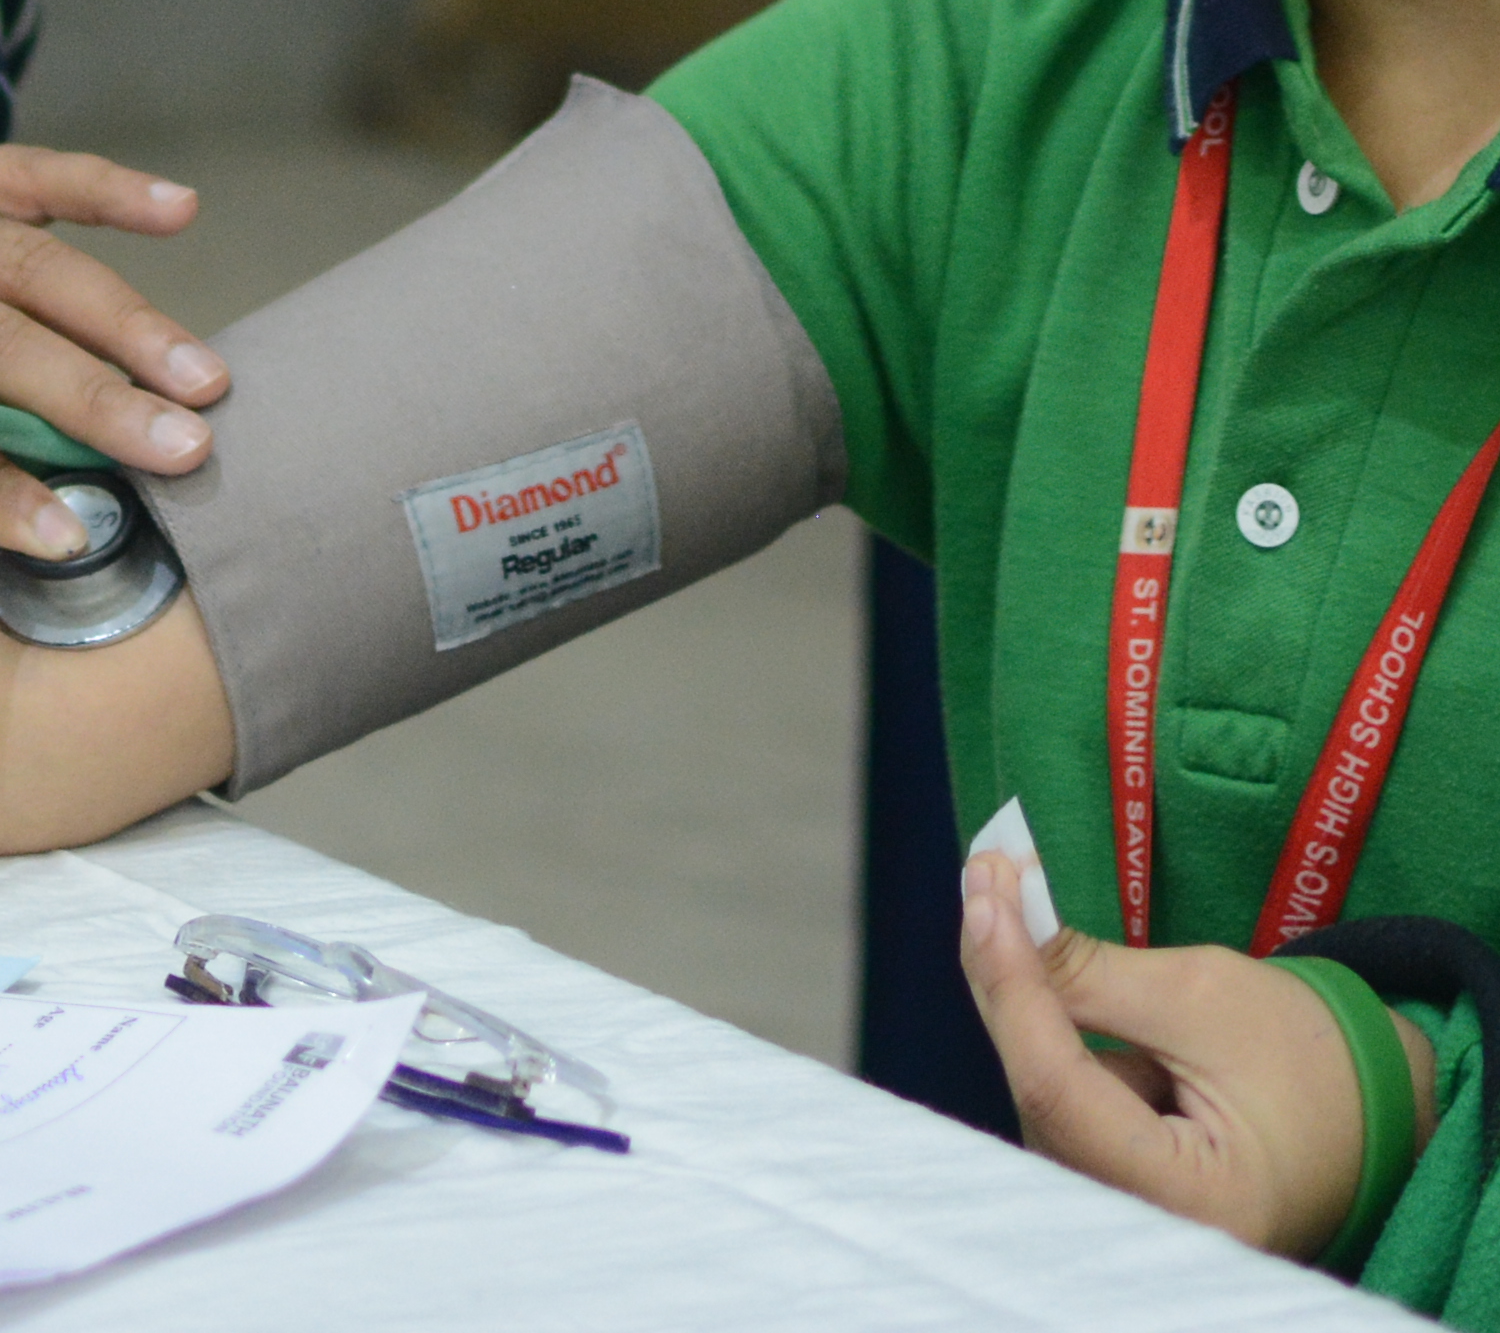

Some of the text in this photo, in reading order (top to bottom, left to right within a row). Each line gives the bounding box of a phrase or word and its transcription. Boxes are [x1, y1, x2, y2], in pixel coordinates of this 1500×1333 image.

[501, 533, 598, 580] Regular
[508, 525, 547, 547] SINCE
[1125, 577, 1159, 937] ST. DOMINIC SAVIO'S
[1278, 611, 1425, 944] AVIO'S HIGH SCHOOL
[32, 1006, 66, 1029] Age
[89, 1015, 140, 1053] Name
